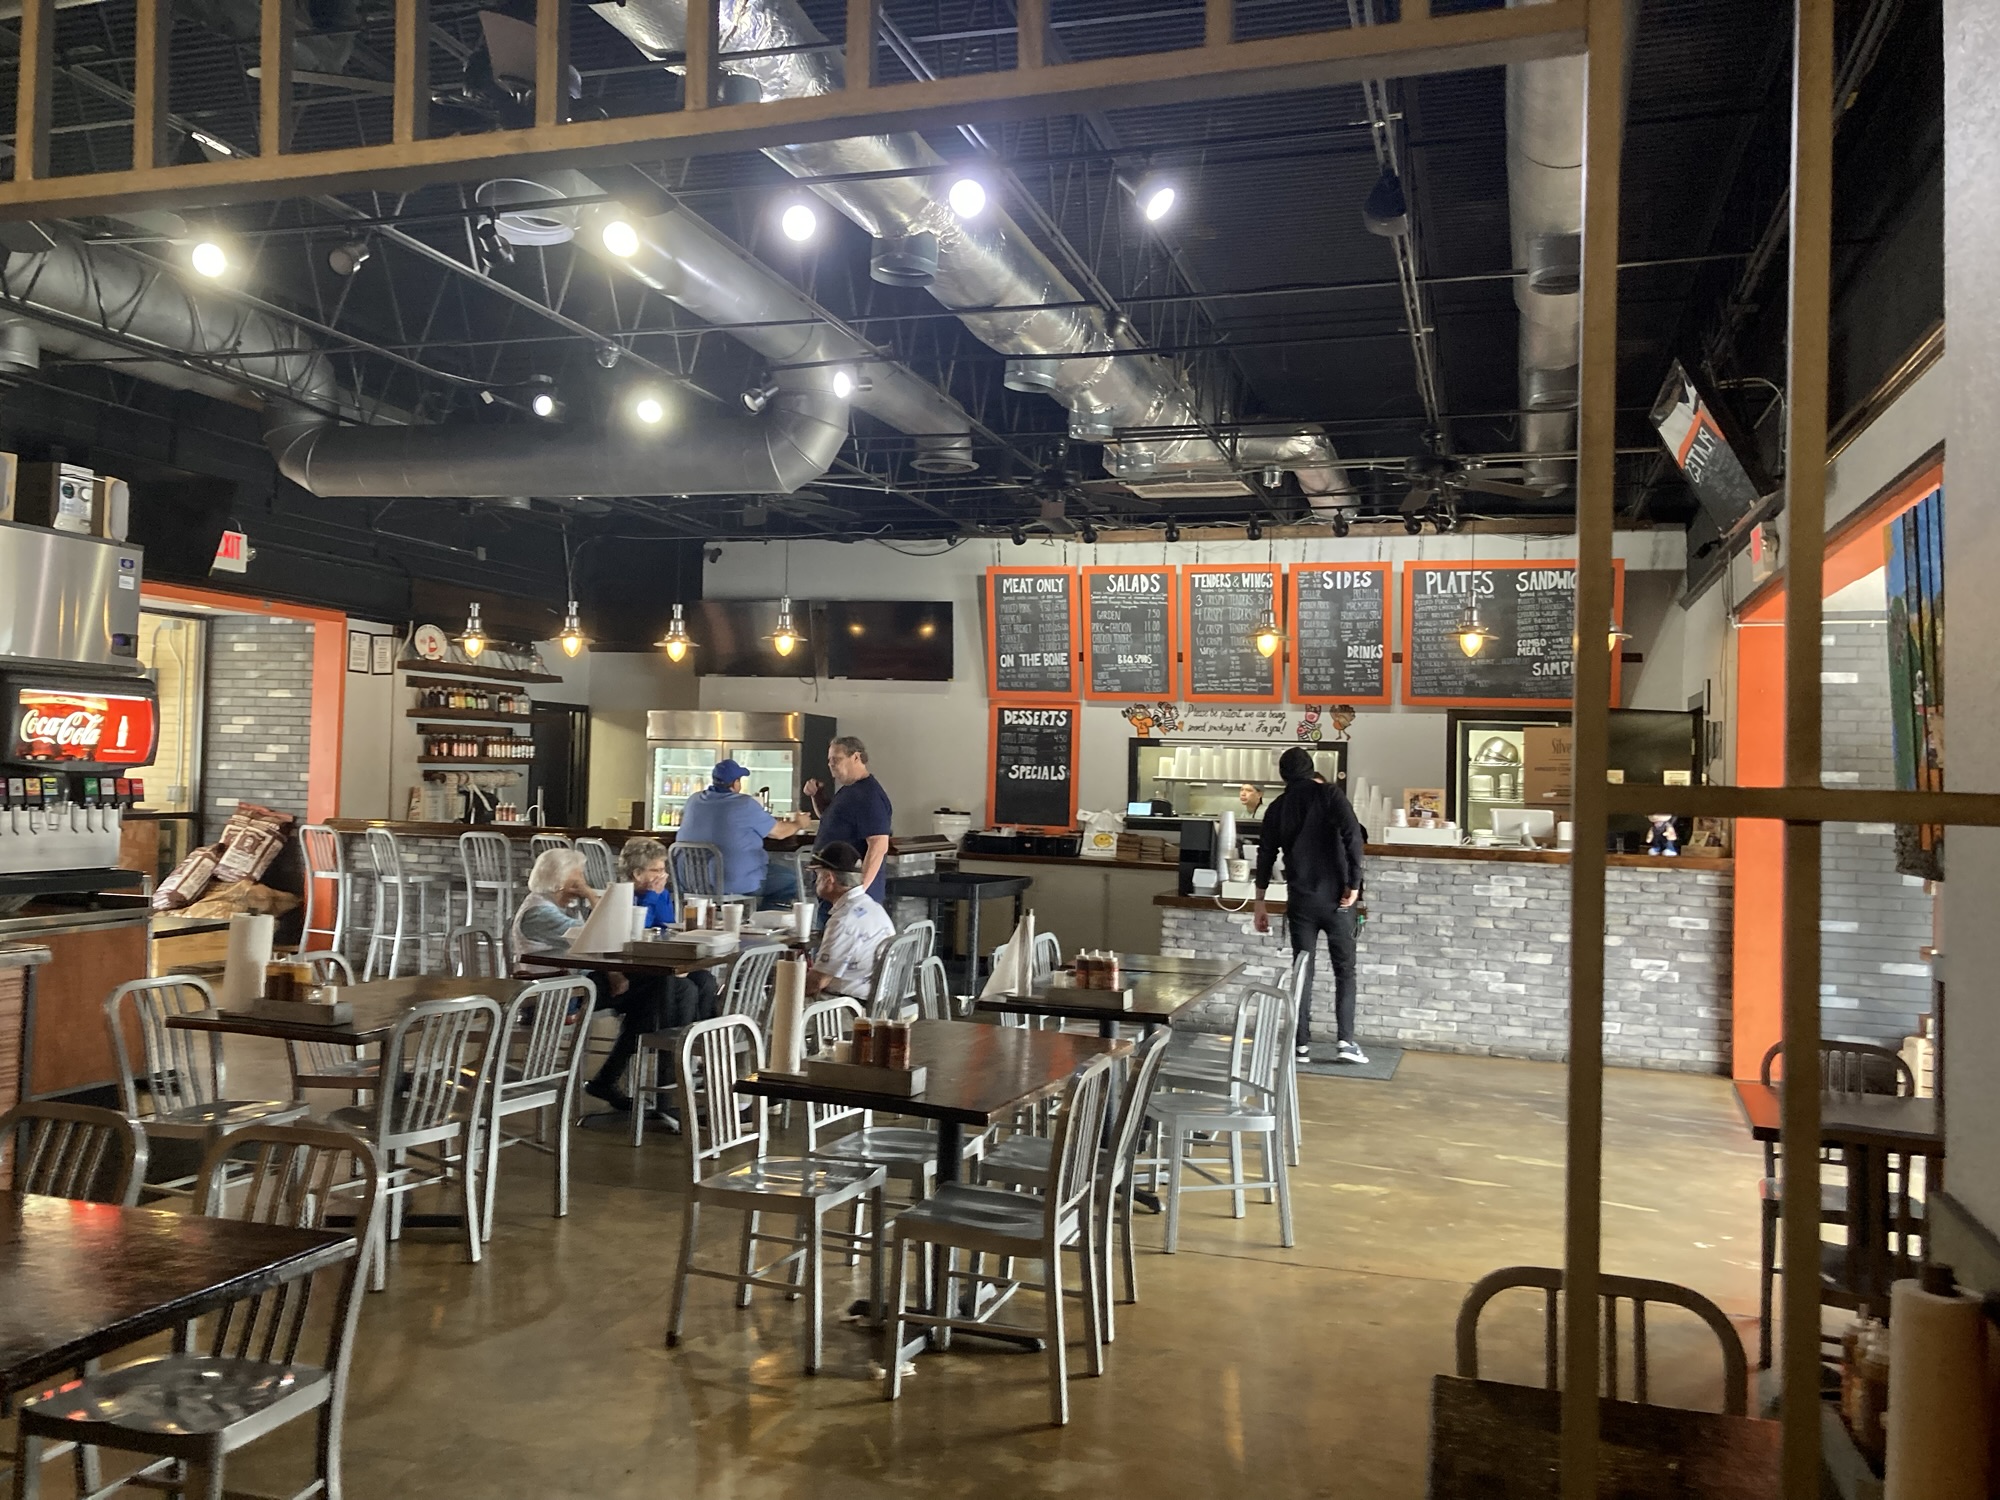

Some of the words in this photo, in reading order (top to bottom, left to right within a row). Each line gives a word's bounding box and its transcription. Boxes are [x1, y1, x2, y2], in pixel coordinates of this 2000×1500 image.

[1003, 578, 1034, 593] MEAT
[1036, 578, 1064, 593] ONLY
[1107, 574, 1160, 593] SALADS
[1191, 573, 1231, 588] TENDERS
[1232, 575, 1239, 587] &
[1242, 573, 1273, 588] WINGS
[1322, 571, 1372, 590] SIDES
[1426, 571, 1494, 594] PLATES
[1516, 571, 1576, 592] SANDWIC
[1195, 594, 1203, 607] 3
[1097, 610, 1120, 620] GARDEN
[1194, 608, 1202, 621] 4
[1197, 623, 1204, 635] 6
[1195, 636, 1205, 647] 10
[1517, 638, 1547, 647] COMBO
[1118, 654, 1133, 664] BBQ
[1347, 644, 1383, 659] DRINKS
[1517, 647, 1544, 656] MEAL
[1000, 654, 1014, 667] ON
[1019, 653, 1041, 666] THE
[1043, 652, 1068, 666] BONE
[1004, 710, 1067, 726] DESSERTS
[1210, 708, 1218, 718] be
[20, 709, 105, 745] Coca-Cola
[1008, 765, 1067, 780] SPECIALS
